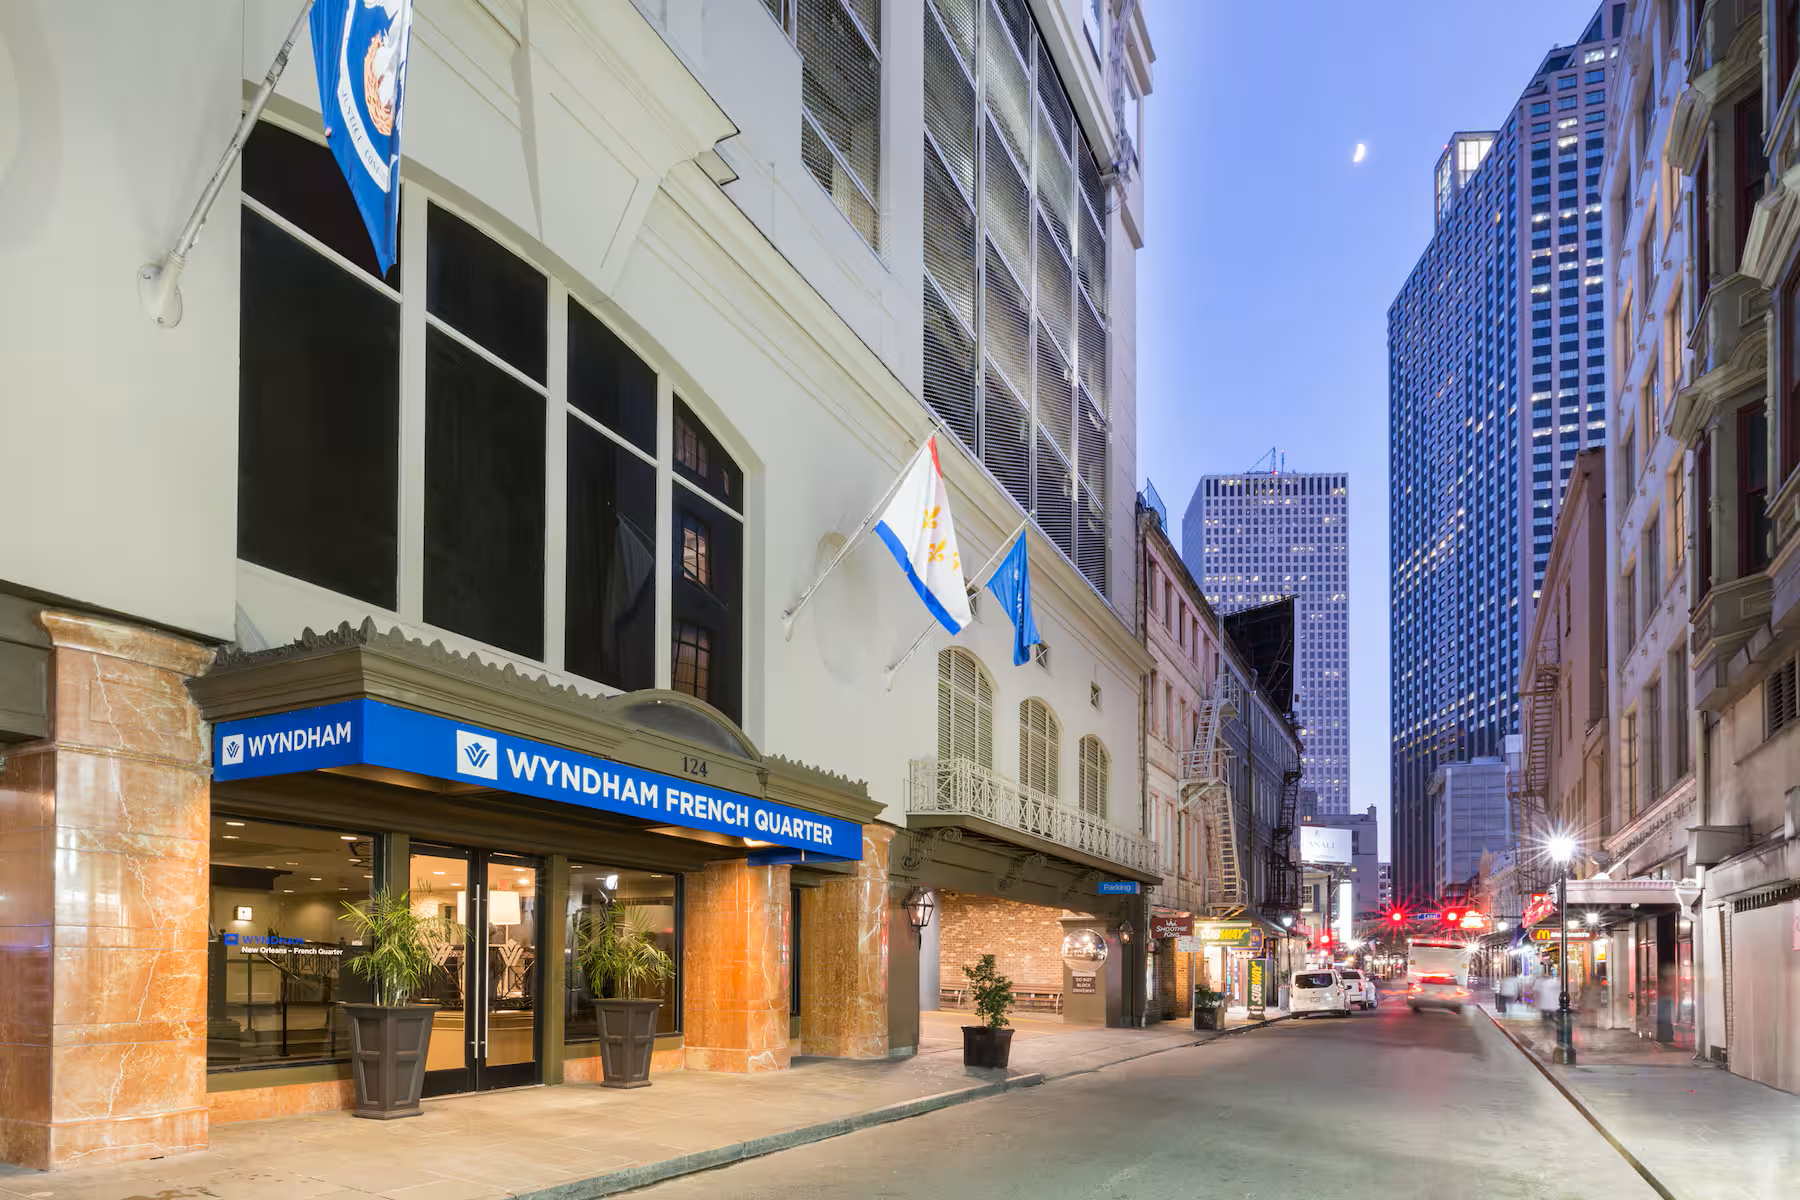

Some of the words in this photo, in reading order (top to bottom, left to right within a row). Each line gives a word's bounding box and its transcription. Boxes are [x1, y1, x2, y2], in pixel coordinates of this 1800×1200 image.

[248, 721, 352, 757] WYNDHAM
[681, 756, 708, 777] 124
[506, 748, 658, 809] WYNDHAM
[666, 787, 749, 828] FRENCH
[754, 808, 833, 846] QUARTER
[1103, 883, 1131, 892] Parking
[241, 935, 304, 945] WYNDHAM
[1200, 928, 1249, 940] SUBWAY
[241, 946, 258, 954] New
[260, 946, 287, 954] Orleans
[293, 947, 317, 955] French
[318, 948, 343, 956] Quarter
[1251, 961, 1262, 1004] SUBWAY
